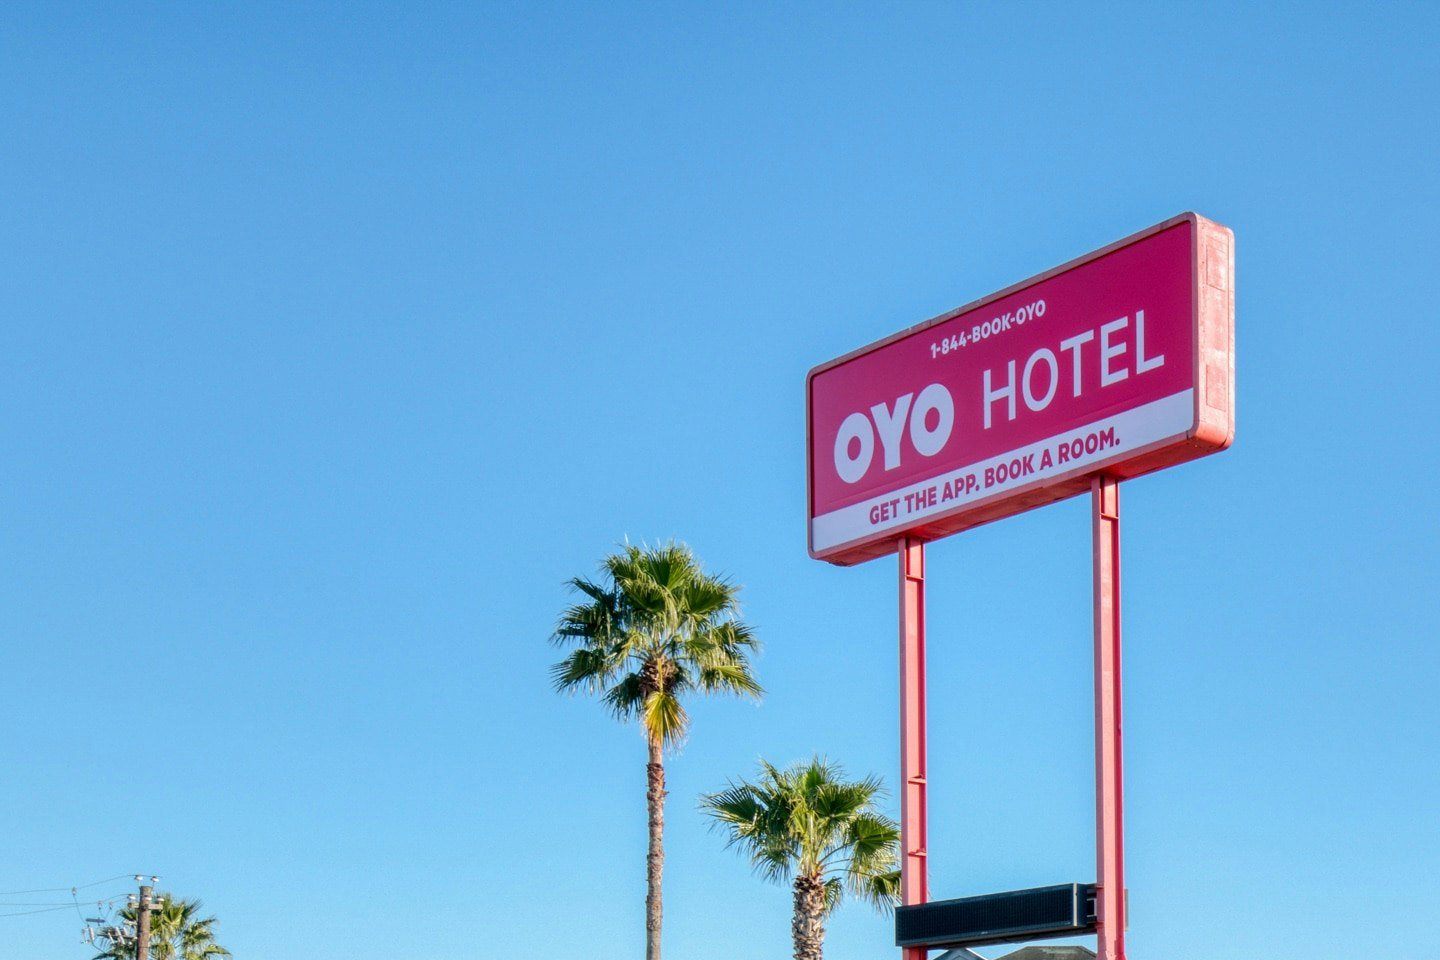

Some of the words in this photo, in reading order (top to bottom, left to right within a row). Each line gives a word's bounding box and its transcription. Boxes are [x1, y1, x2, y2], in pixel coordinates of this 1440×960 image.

[931, 300, 1046, 359] 1-844-BOOK-OYO
[834, 383, 955, 484] OYO
[983, 310, 1165, 430] HOTEL
[869, 498, 901, 525] GET
[904, 486, 937, 514] THE
[941, 473, 980, 503] APP.
[984, 453, 1035, 489] BOOK
[1039, 448, 1054, 471] A
[1058, 426, 1121, 465] ROOM.
